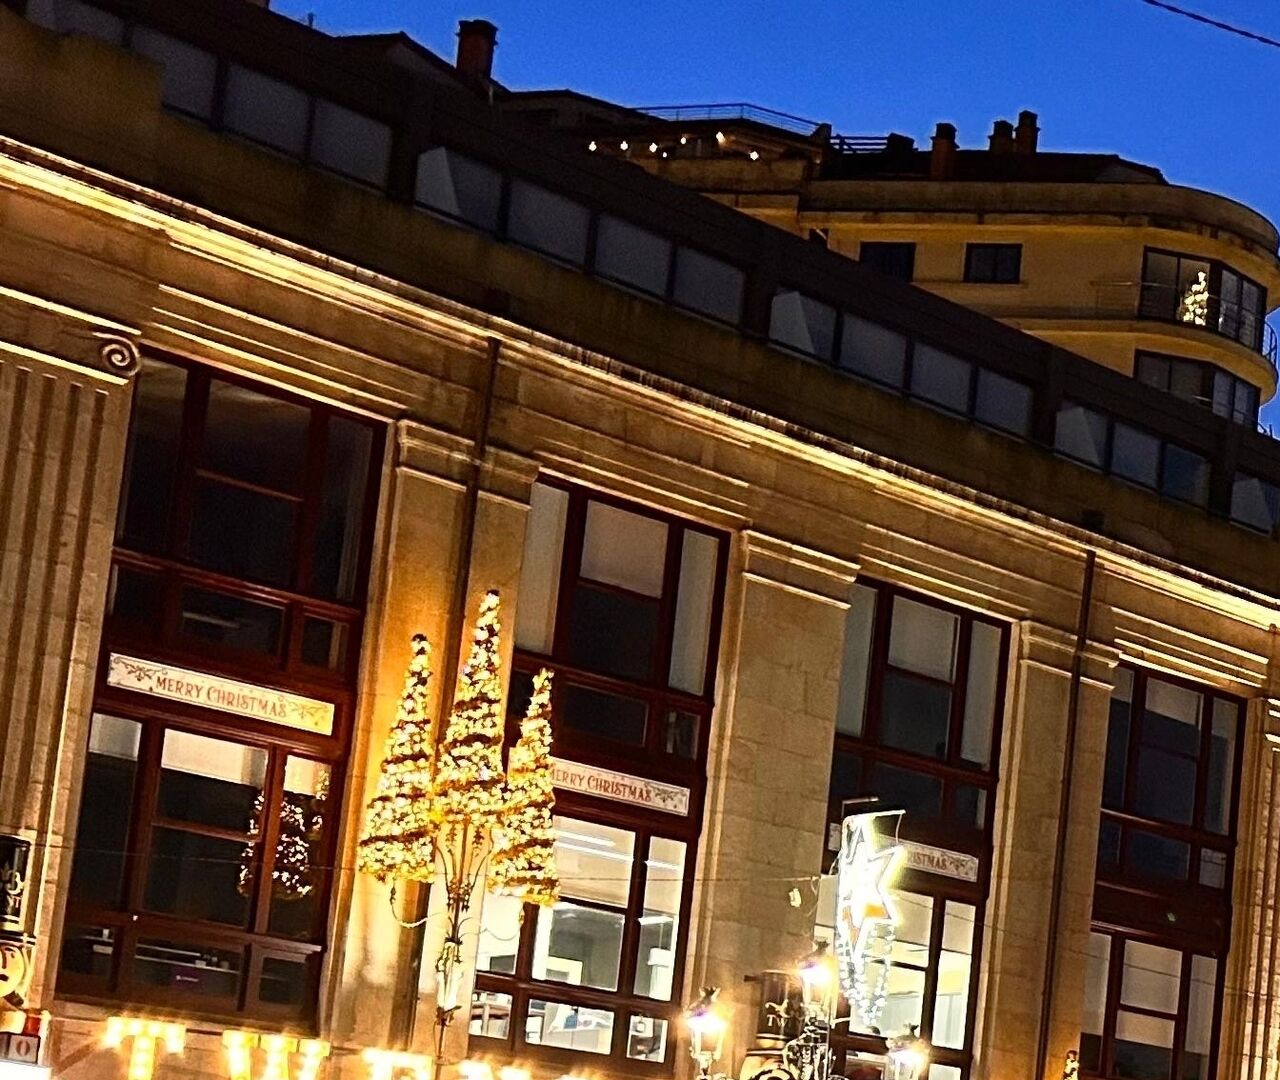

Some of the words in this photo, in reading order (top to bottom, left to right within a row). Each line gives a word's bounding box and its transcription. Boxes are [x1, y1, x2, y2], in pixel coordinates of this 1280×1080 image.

[156, 676, 203, 699] MERRY
[206, 686, 287, 718] CHRISTMAS
[587, 775, 651, 802] CHRISTMAS
